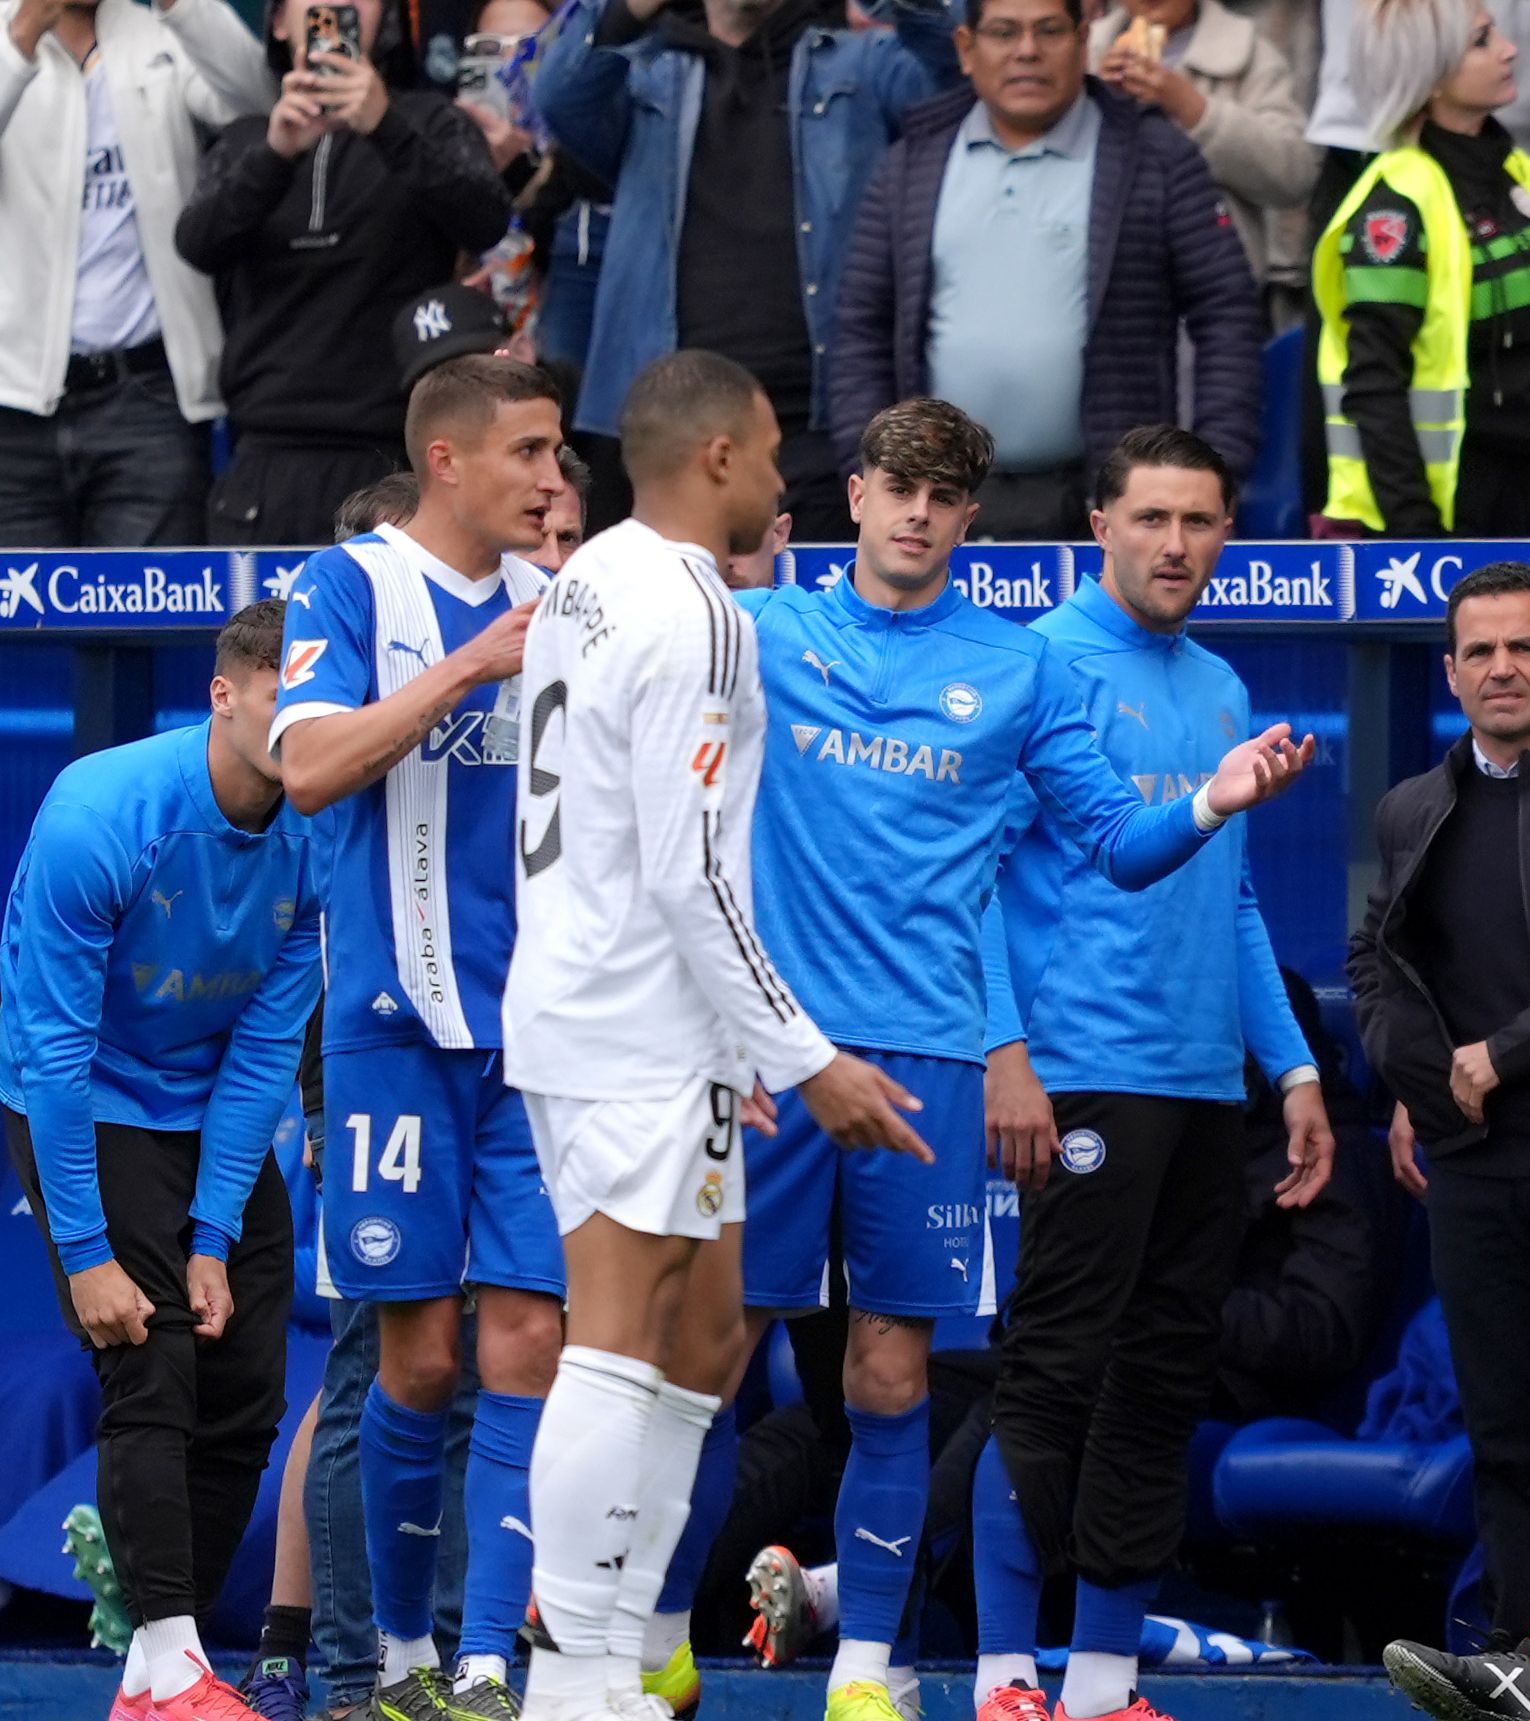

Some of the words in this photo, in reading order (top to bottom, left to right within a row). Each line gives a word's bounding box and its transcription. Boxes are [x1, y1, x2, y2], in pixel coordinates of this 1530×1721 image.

[413, 300, 452, 342] NY
[48, 565, 224, 613] CaixaBank
[817, 729, 962, 784] AMBAR
[414, 823, 429, 901] álava
[421, 927, 444, 1004] araba
[345, 1113, 422, 1193] 14
[706, 1082, 735, 1161] 9
